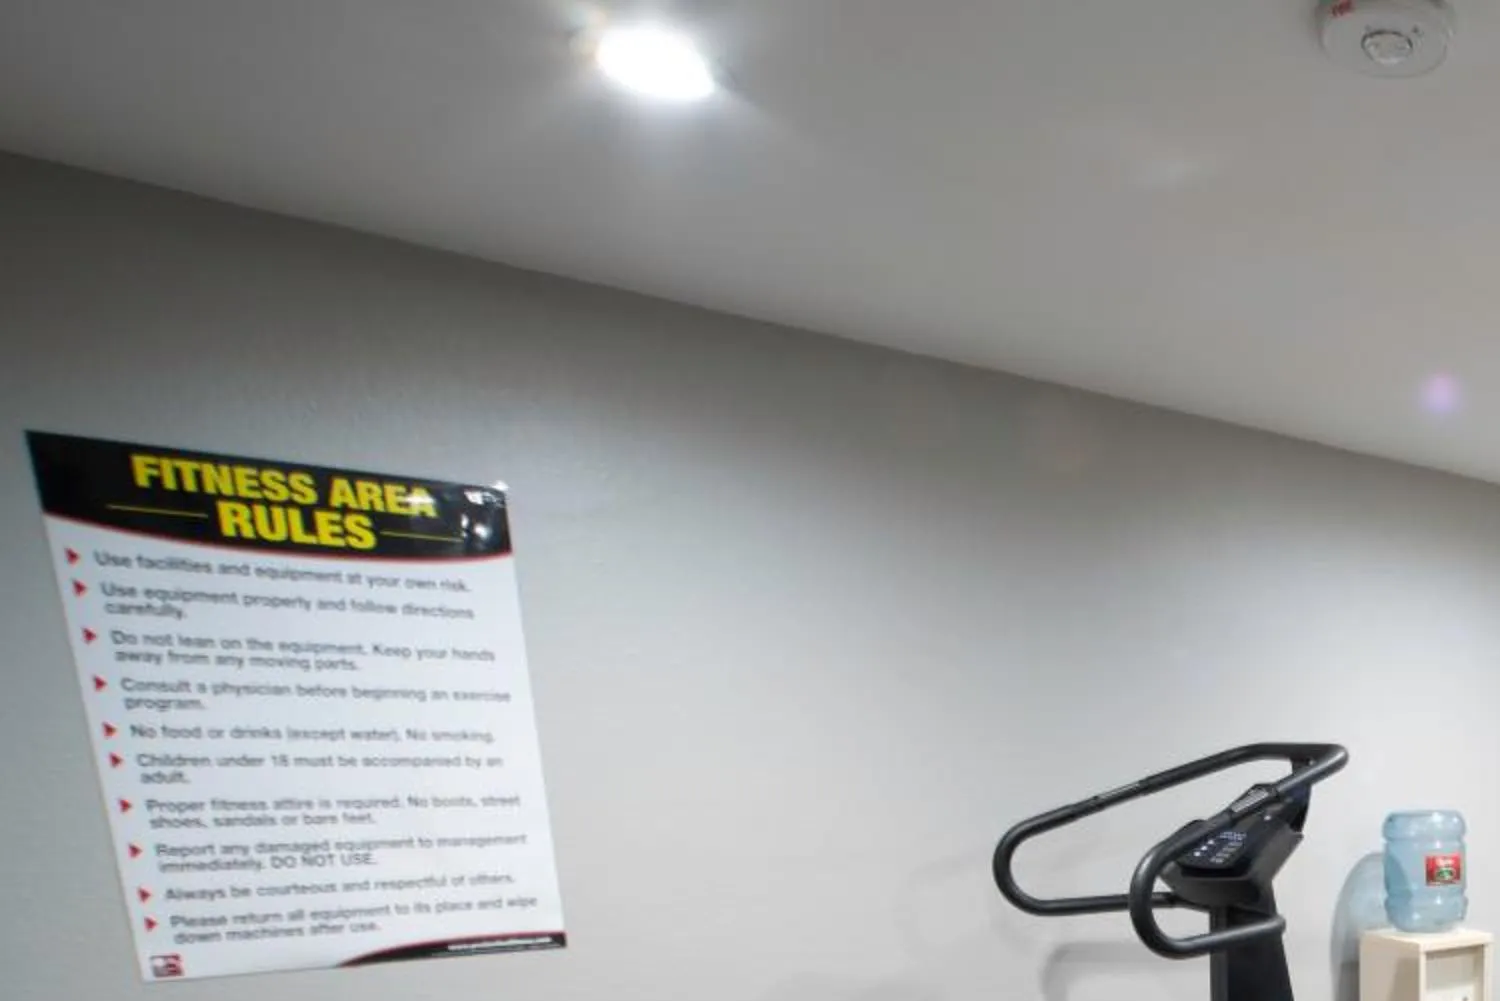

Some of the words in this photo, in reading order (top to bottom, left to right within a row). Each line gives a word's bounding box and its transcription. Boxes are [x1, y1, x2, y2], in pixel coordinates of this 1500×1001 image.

[131, 455, 317, 505] FITNESS
[330, 475, 437, 519] AREA
[215, 500, 376, 550] RULES
[94, 550, 132, 567] Use
[136, 555, 212, 574] facilities
[218, 563, 250, 577] and
[255, 567, 342, 583] equipment
[347, 572, 361, 585] at
[367, 575, 400, 589] your
[405, 578, 437, 589] own
[439, 579, 471, 592] risk.
[100, 583, 137, 598] Use
[143, 588, 237, 604] equipment
[243, 593, 311, 611] properly
[317, 598, 346, 611] and
[350, 600, 397, 614] follow
[402, 602, 474, 619] directions
[104, 602, 187, 620] carefully.
[111, 629, 137, 645] Do
[142, 633, 173, 646] not
[178, 634, 215, 648] lean
[220, 638, 242, 650] on
[246, 636, 273, 651] the
[372, 644, 411, 659] Keep
[416, 648, 447, 660] your
[451, 648, 495, 662] hands
[114, 651, 162, 665] away
[167, 650, 209, 664] from
[215, 653, 244, 669] any
[248, 655, 310, 671] moving
[315, 658, 359, 671] parts.
[120, 677, 192, 693] Consult
[197, 682, 206, 694] a
[211, 681, 290, 698] physician
[296, 684, 347, 698] before
[351, 686, 427, 702] beginning
[431, 689, 448, 700] an
[123, 698, 208, 713] program.
[130, 724, 157, 739] No
[161, 724, 202, 739] food
[207, 727, 224, 739] or
[230, 726, 282, 740] drinks
[405, 728, 426, 740] No
[136, 753, 210, 767] Children
[216, 754, 265, 767] under
[293, 756, 333, 768] must
[338, 756, 356, 767] be
[465, 755, 481, 769] by
[487, 757, 503, 768] an
[140, 770, 192, 784] adult.
[146, 799, 205, 814] Proper
[318, 798, 331, 810] is
[407, 794, 428, 807] No
[213, 814, 277, 827] sandals
[281, 815, 297, 826] or
[302, 813, 338, 825] bare
[155, 843, 214, 857] Report
[220, 844, 249, 856] any
[255, 841, 329, 855] damaged
[334, 837, 413, 851] equipment
[418, 836, 432, 848] to
[271, 855, 297, 869] DO
[302, 854, 335, 868] NOT
[341, 852, 377, 866] USE.
[166, 888, 226, 901] Always
[230, 885, 250, 898] be
[256, 882, 336, 896] courteous
[342, 880, 370, 892] and
[451, 874, 465, 887] of
[170, 915, 228, 928] Please
[232, 912, 282, 925] return
[287, 910, 304, 922] all
[310, 905, 390, 921] equipment
[395, 903, 409, 915] to
[435, 900, 472, 914] place
[478, 897, 502, 909] and
[507, 896, 537, 909] wipe
[174, 931, 222, 944] down
[226, 927, 304, 942] machines
[310, 924, 344, 937] after
